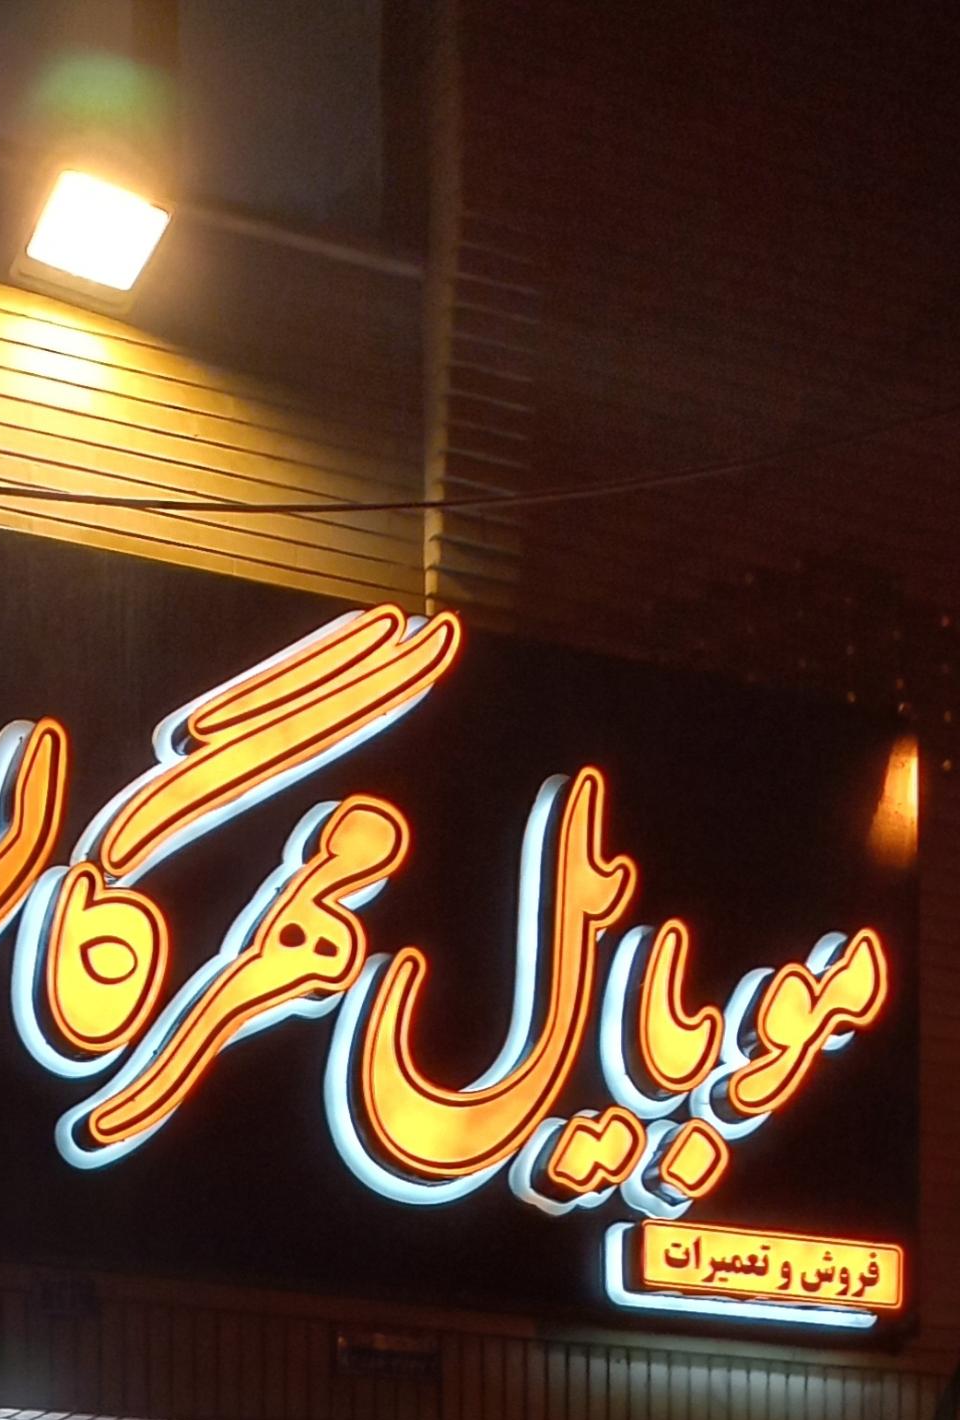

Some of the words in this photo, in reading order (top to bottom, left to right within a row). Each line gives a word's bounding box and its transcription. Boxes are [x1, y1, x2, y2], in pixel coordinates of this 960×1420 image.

[364, 766, 888, 1198] موبایل
[664, 1236, 771, 1283] تعمیرات
[777, 1260, 792, 1290] و
[800, 1251, 880, 1298] فروش
